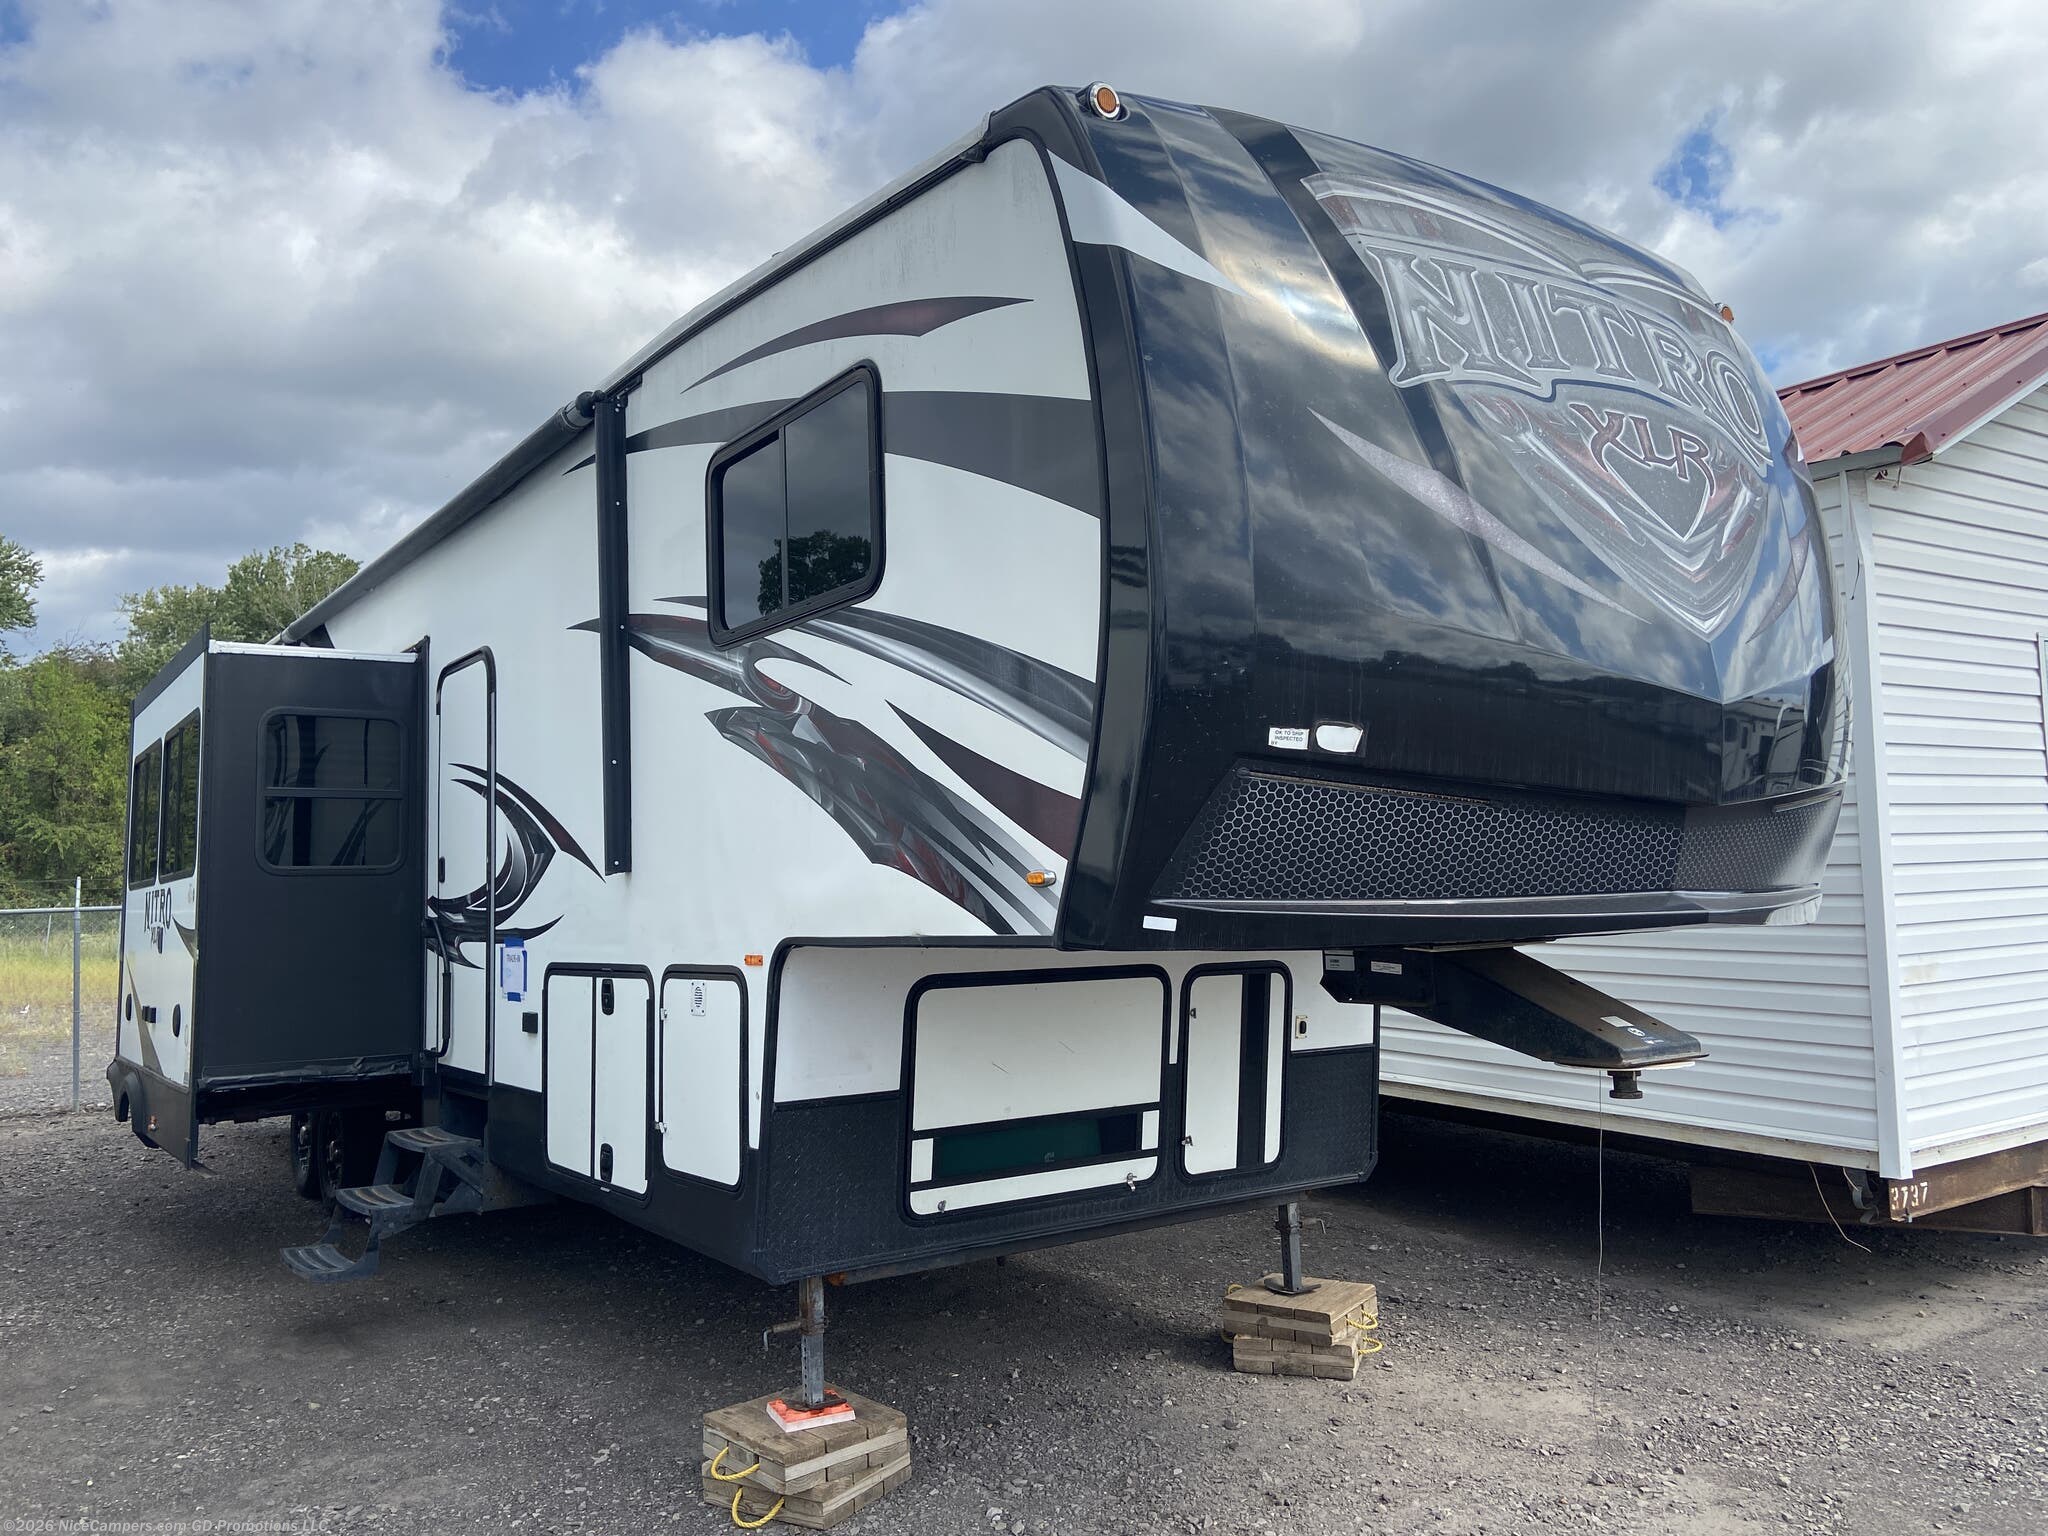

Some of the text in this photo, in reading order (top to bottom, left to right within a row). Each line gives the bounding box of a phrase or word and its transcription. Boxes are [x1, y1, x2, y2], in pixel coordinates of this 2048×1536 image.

[1365, 245, 1773, 478] NITRO
[1567, 402, 1717, 497] XLR
[144, 888, 172, 932] NITRO
